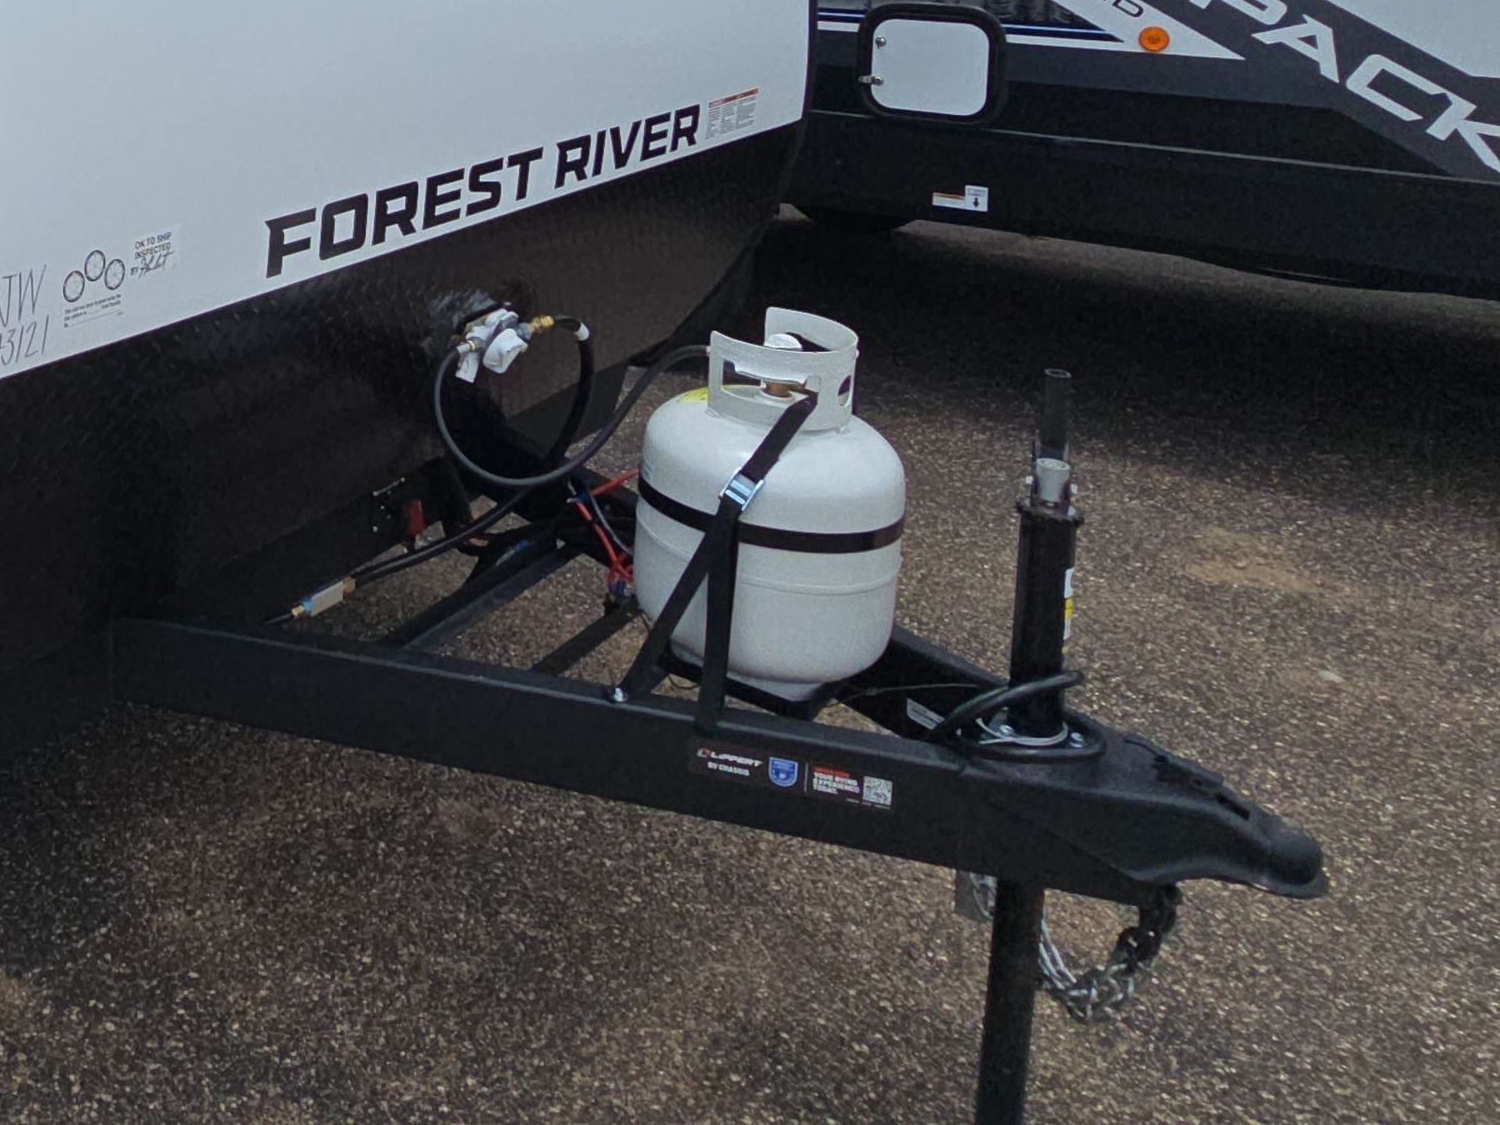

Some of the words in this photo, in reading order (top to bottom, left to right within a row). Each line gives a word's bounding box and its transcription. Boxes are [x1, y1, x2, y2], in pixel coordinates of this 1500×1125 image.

[264, 146, 544, 279] FOREST
[554, 103, 700, 190] RIVER
[134, 241, 172, 260] INSPECTED
[146, 236, 156, 246] TO
